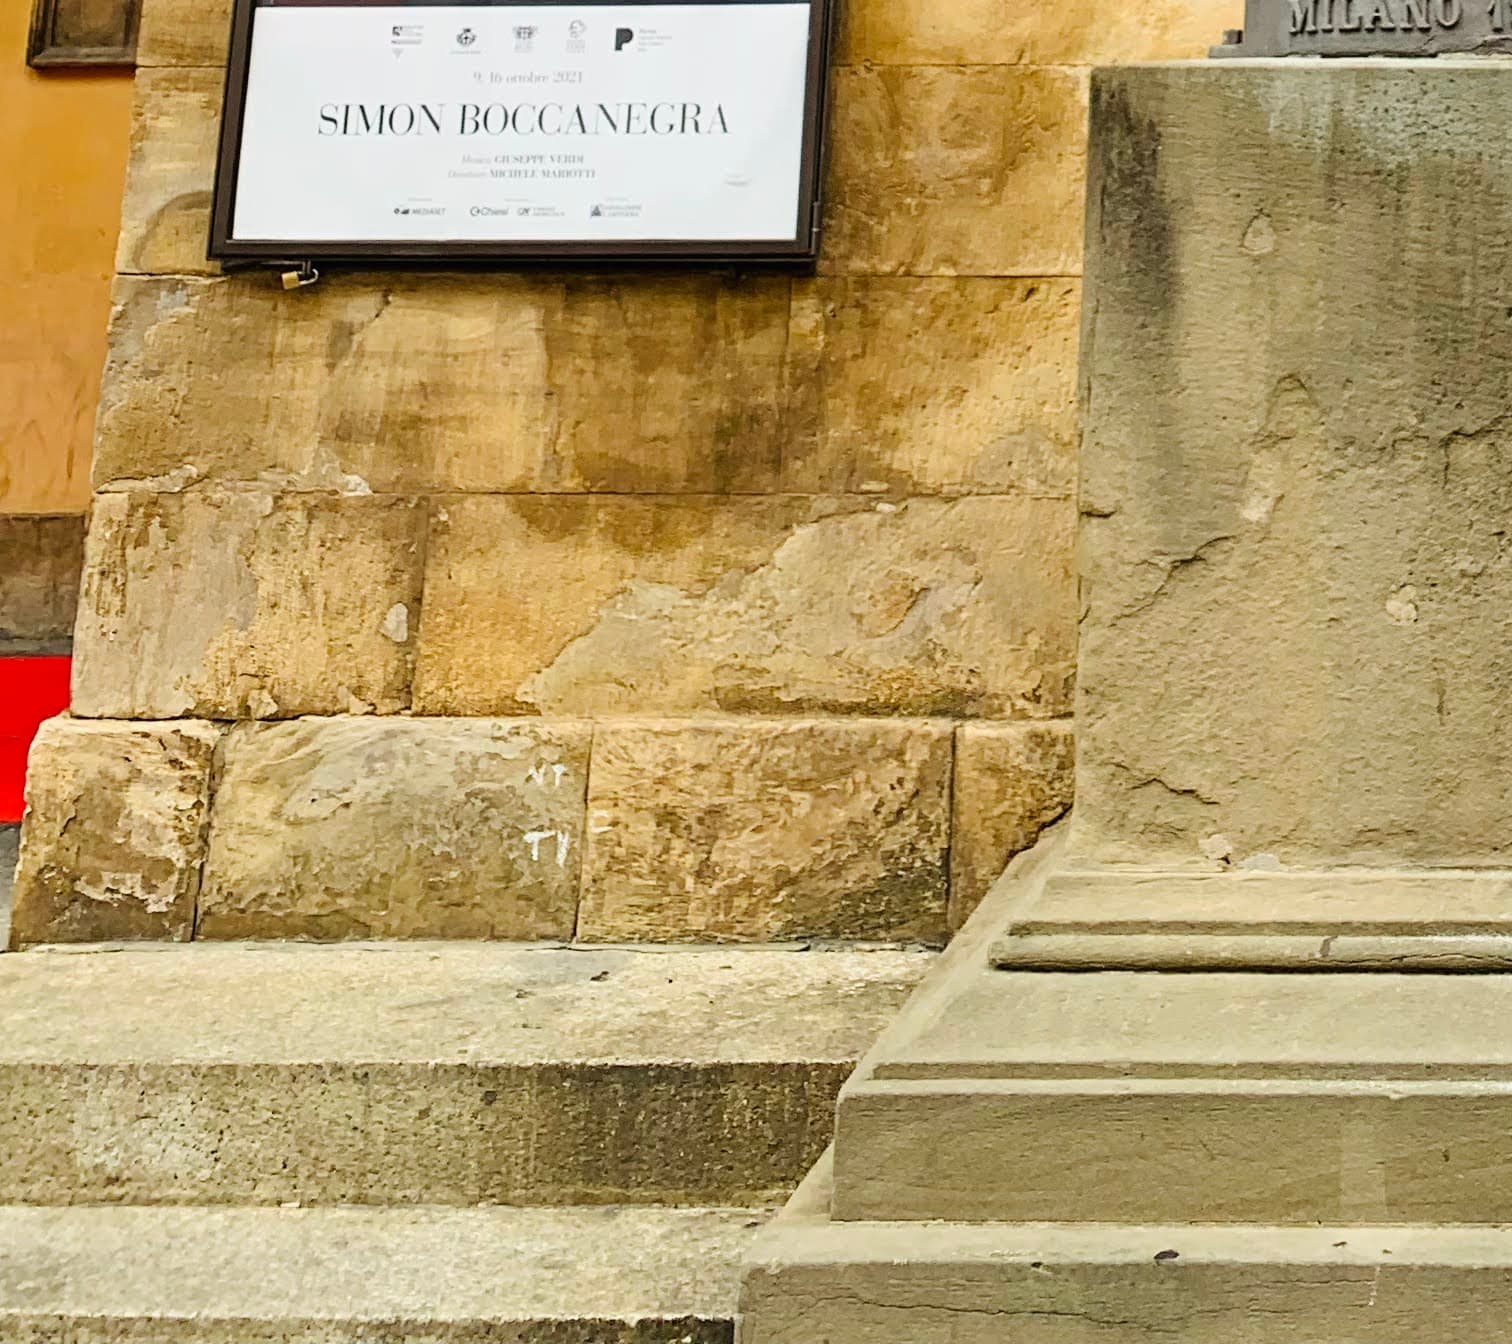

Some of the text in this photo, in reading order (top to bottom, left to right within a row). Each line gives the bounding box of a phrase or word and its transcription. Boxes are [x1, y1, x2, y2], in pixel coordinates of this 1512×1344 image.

[505, 71, 549, 85] ottobre
[552, 71, 583, 84] 2021
[318, 103, 732, 136] SIMON BOCCANEGRA
